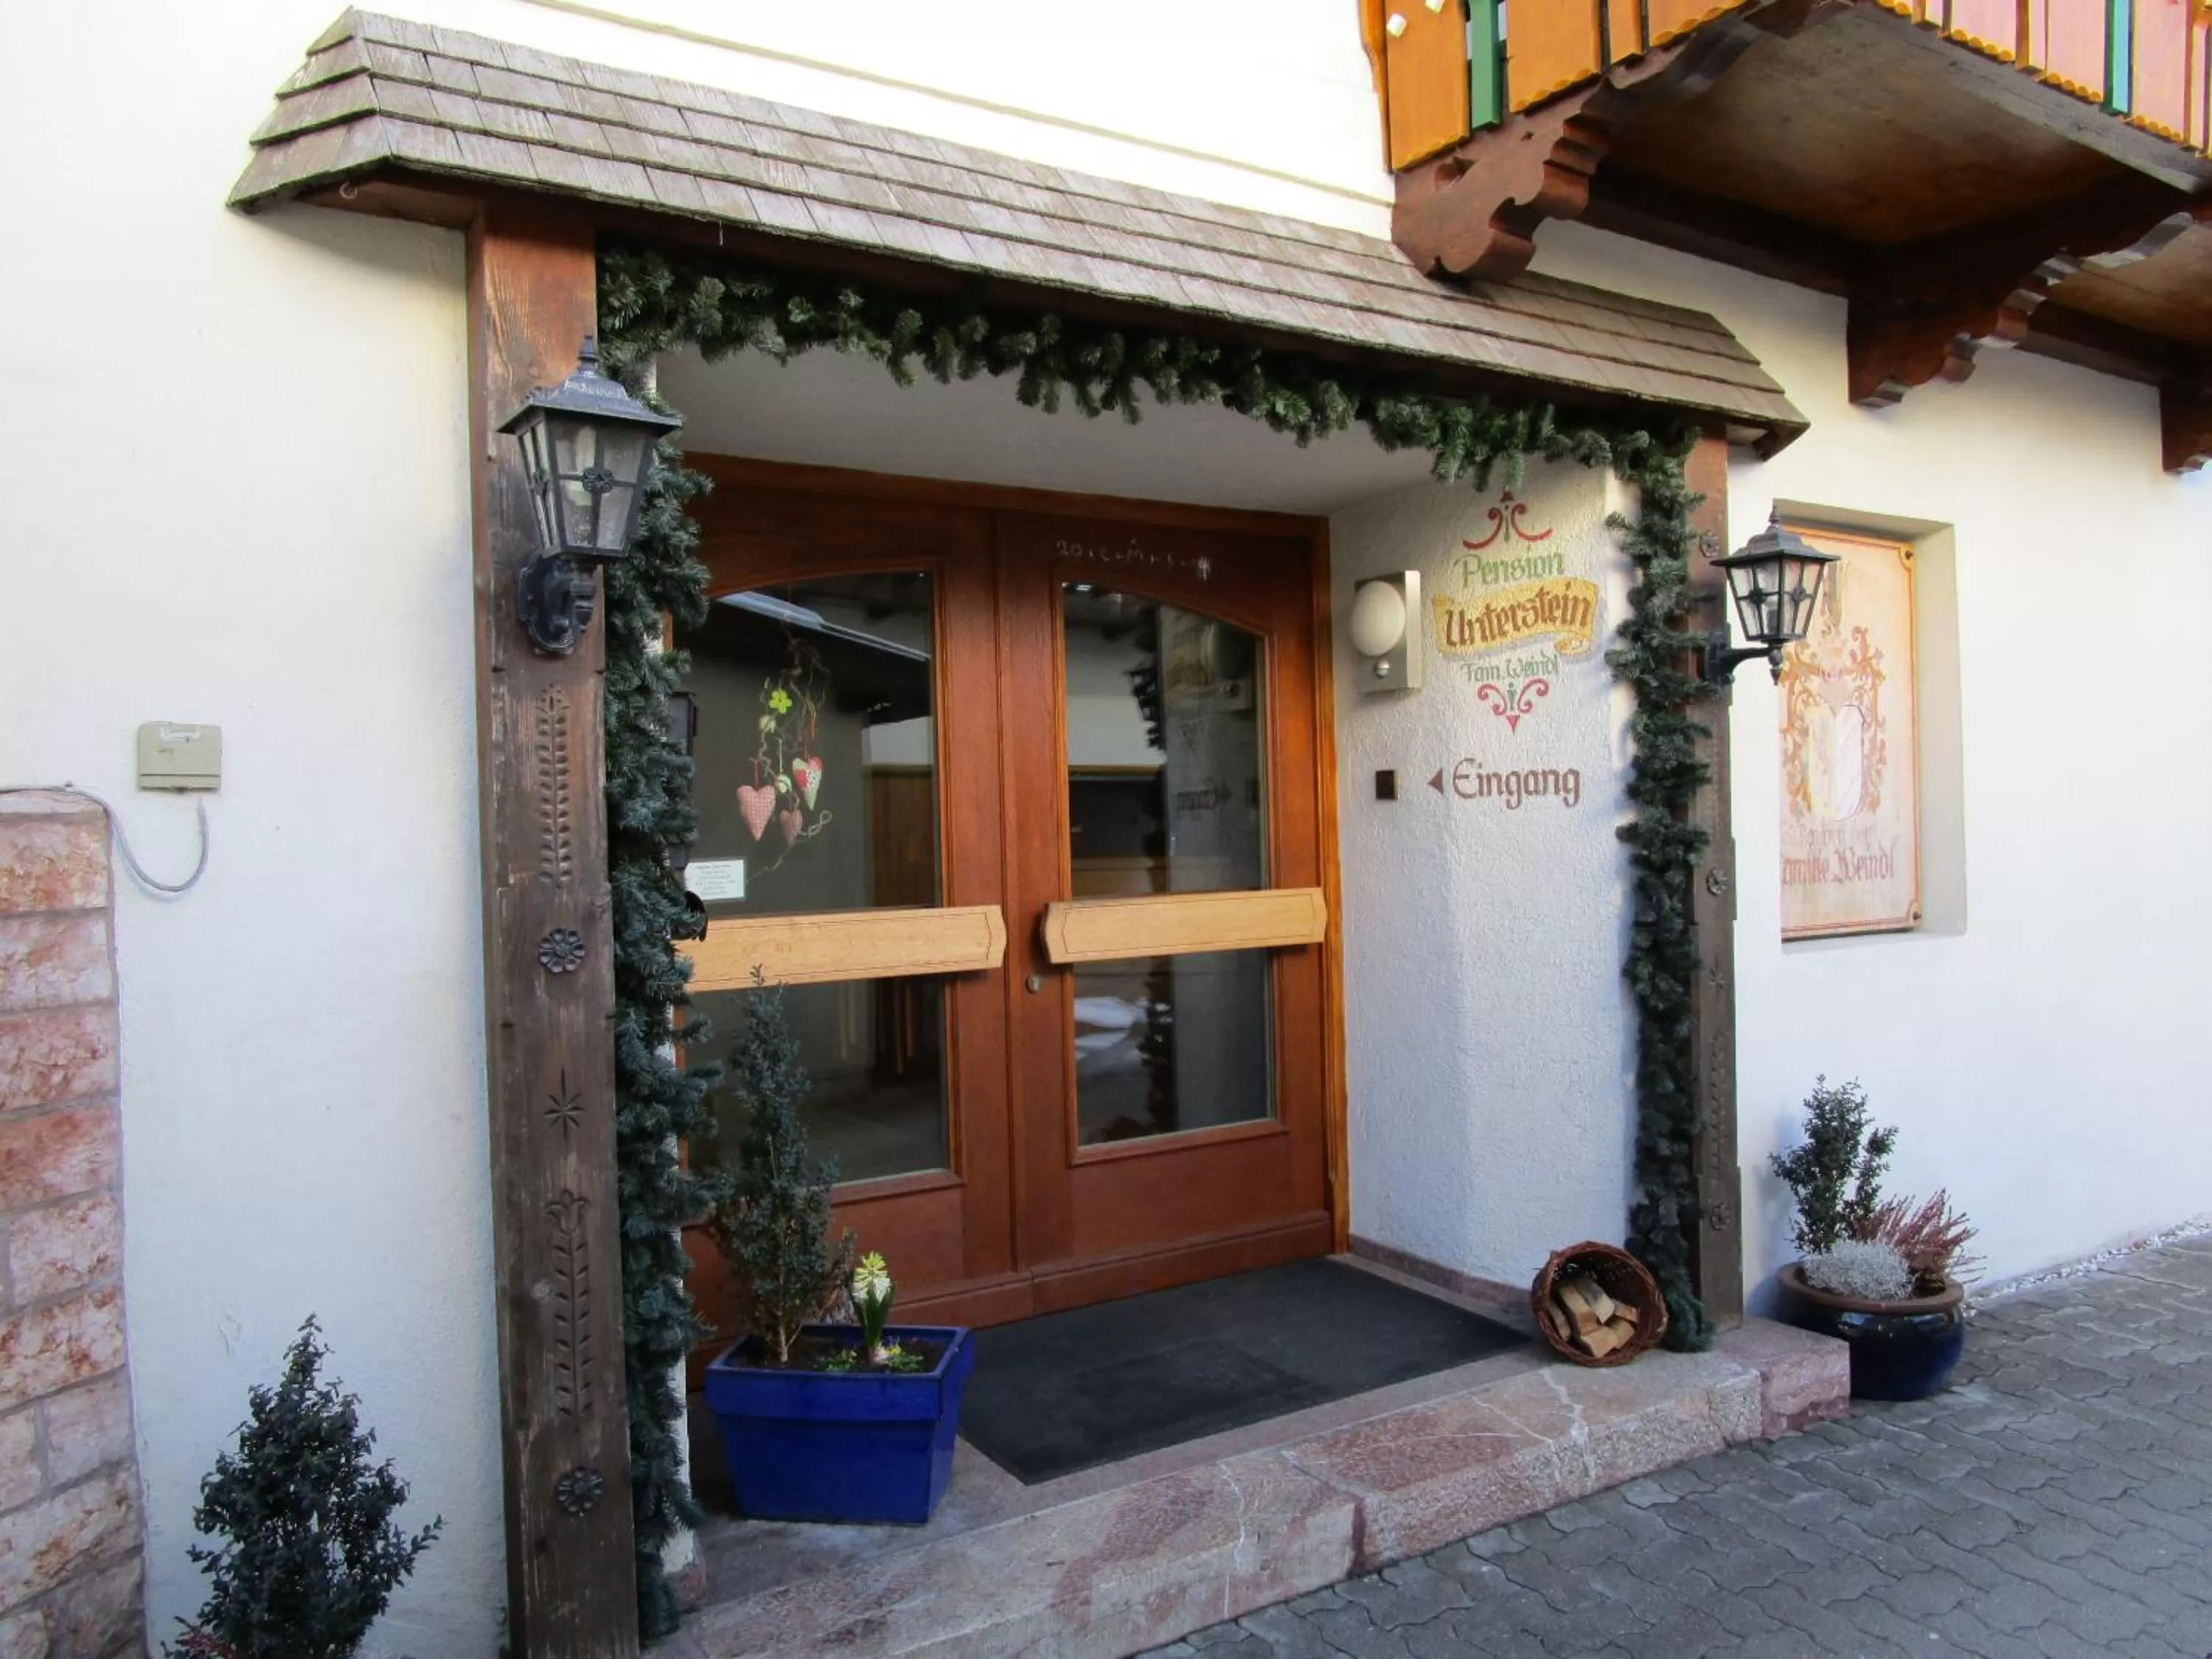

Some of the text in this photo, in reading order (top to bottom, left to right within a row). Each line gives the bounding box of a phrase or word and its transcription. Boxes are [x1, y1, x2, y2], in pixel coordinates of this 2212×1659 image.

[1453, 547, 1565, 588] Pension
[1444, 581, 1592, 647] Unterstein
[1453, 757, 1581, 810] Eingang
